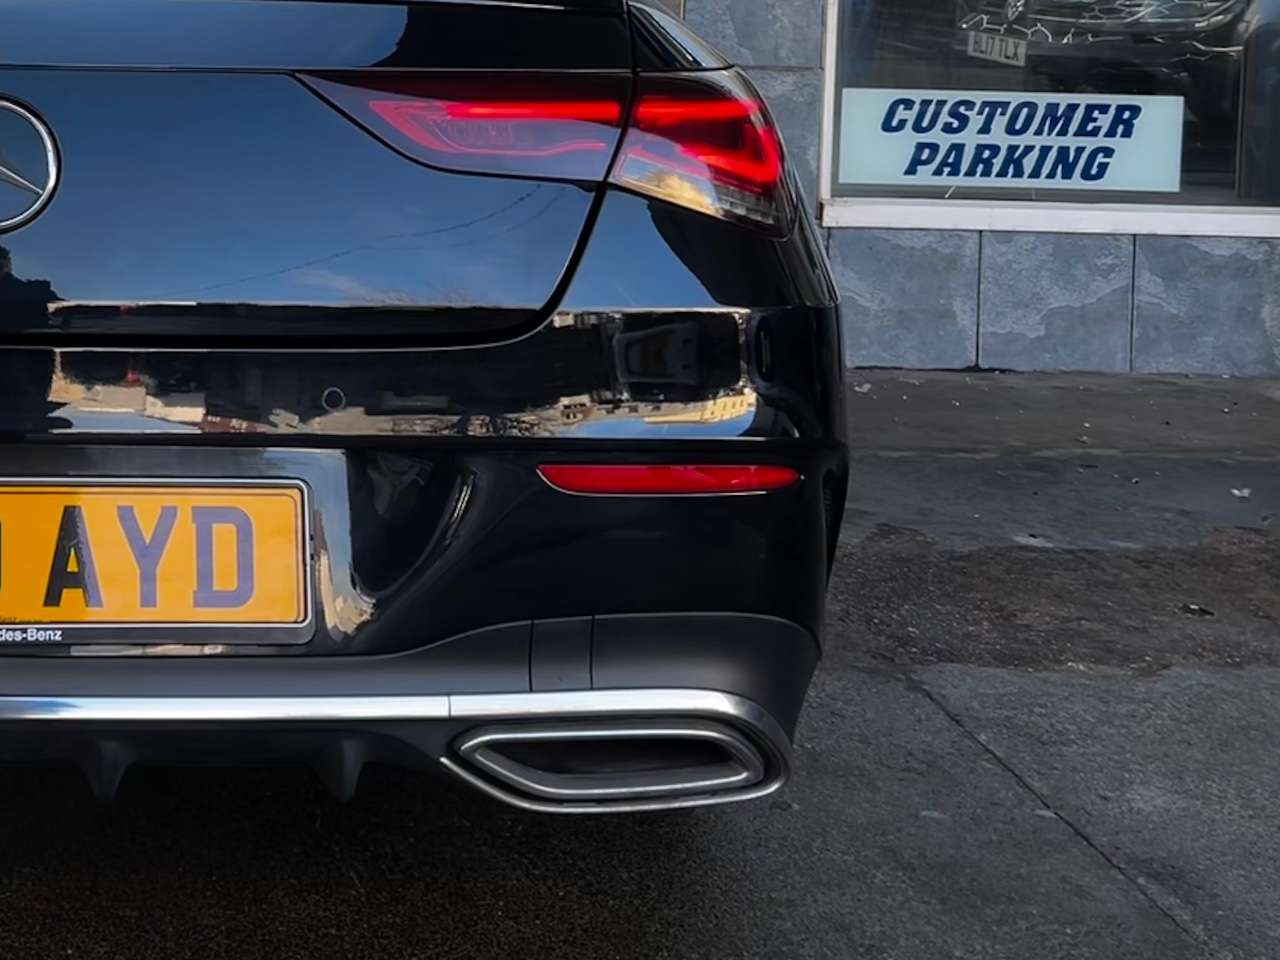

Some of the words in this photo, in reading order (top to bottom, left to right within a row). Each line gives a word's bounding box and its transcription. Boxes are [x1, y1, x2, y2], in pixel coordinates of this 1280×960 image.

[880, 97, 1143, 139] CUSTOMER
[903, 142, 1116, 182] PARKING
[42, 505, 256, 608] AYD
